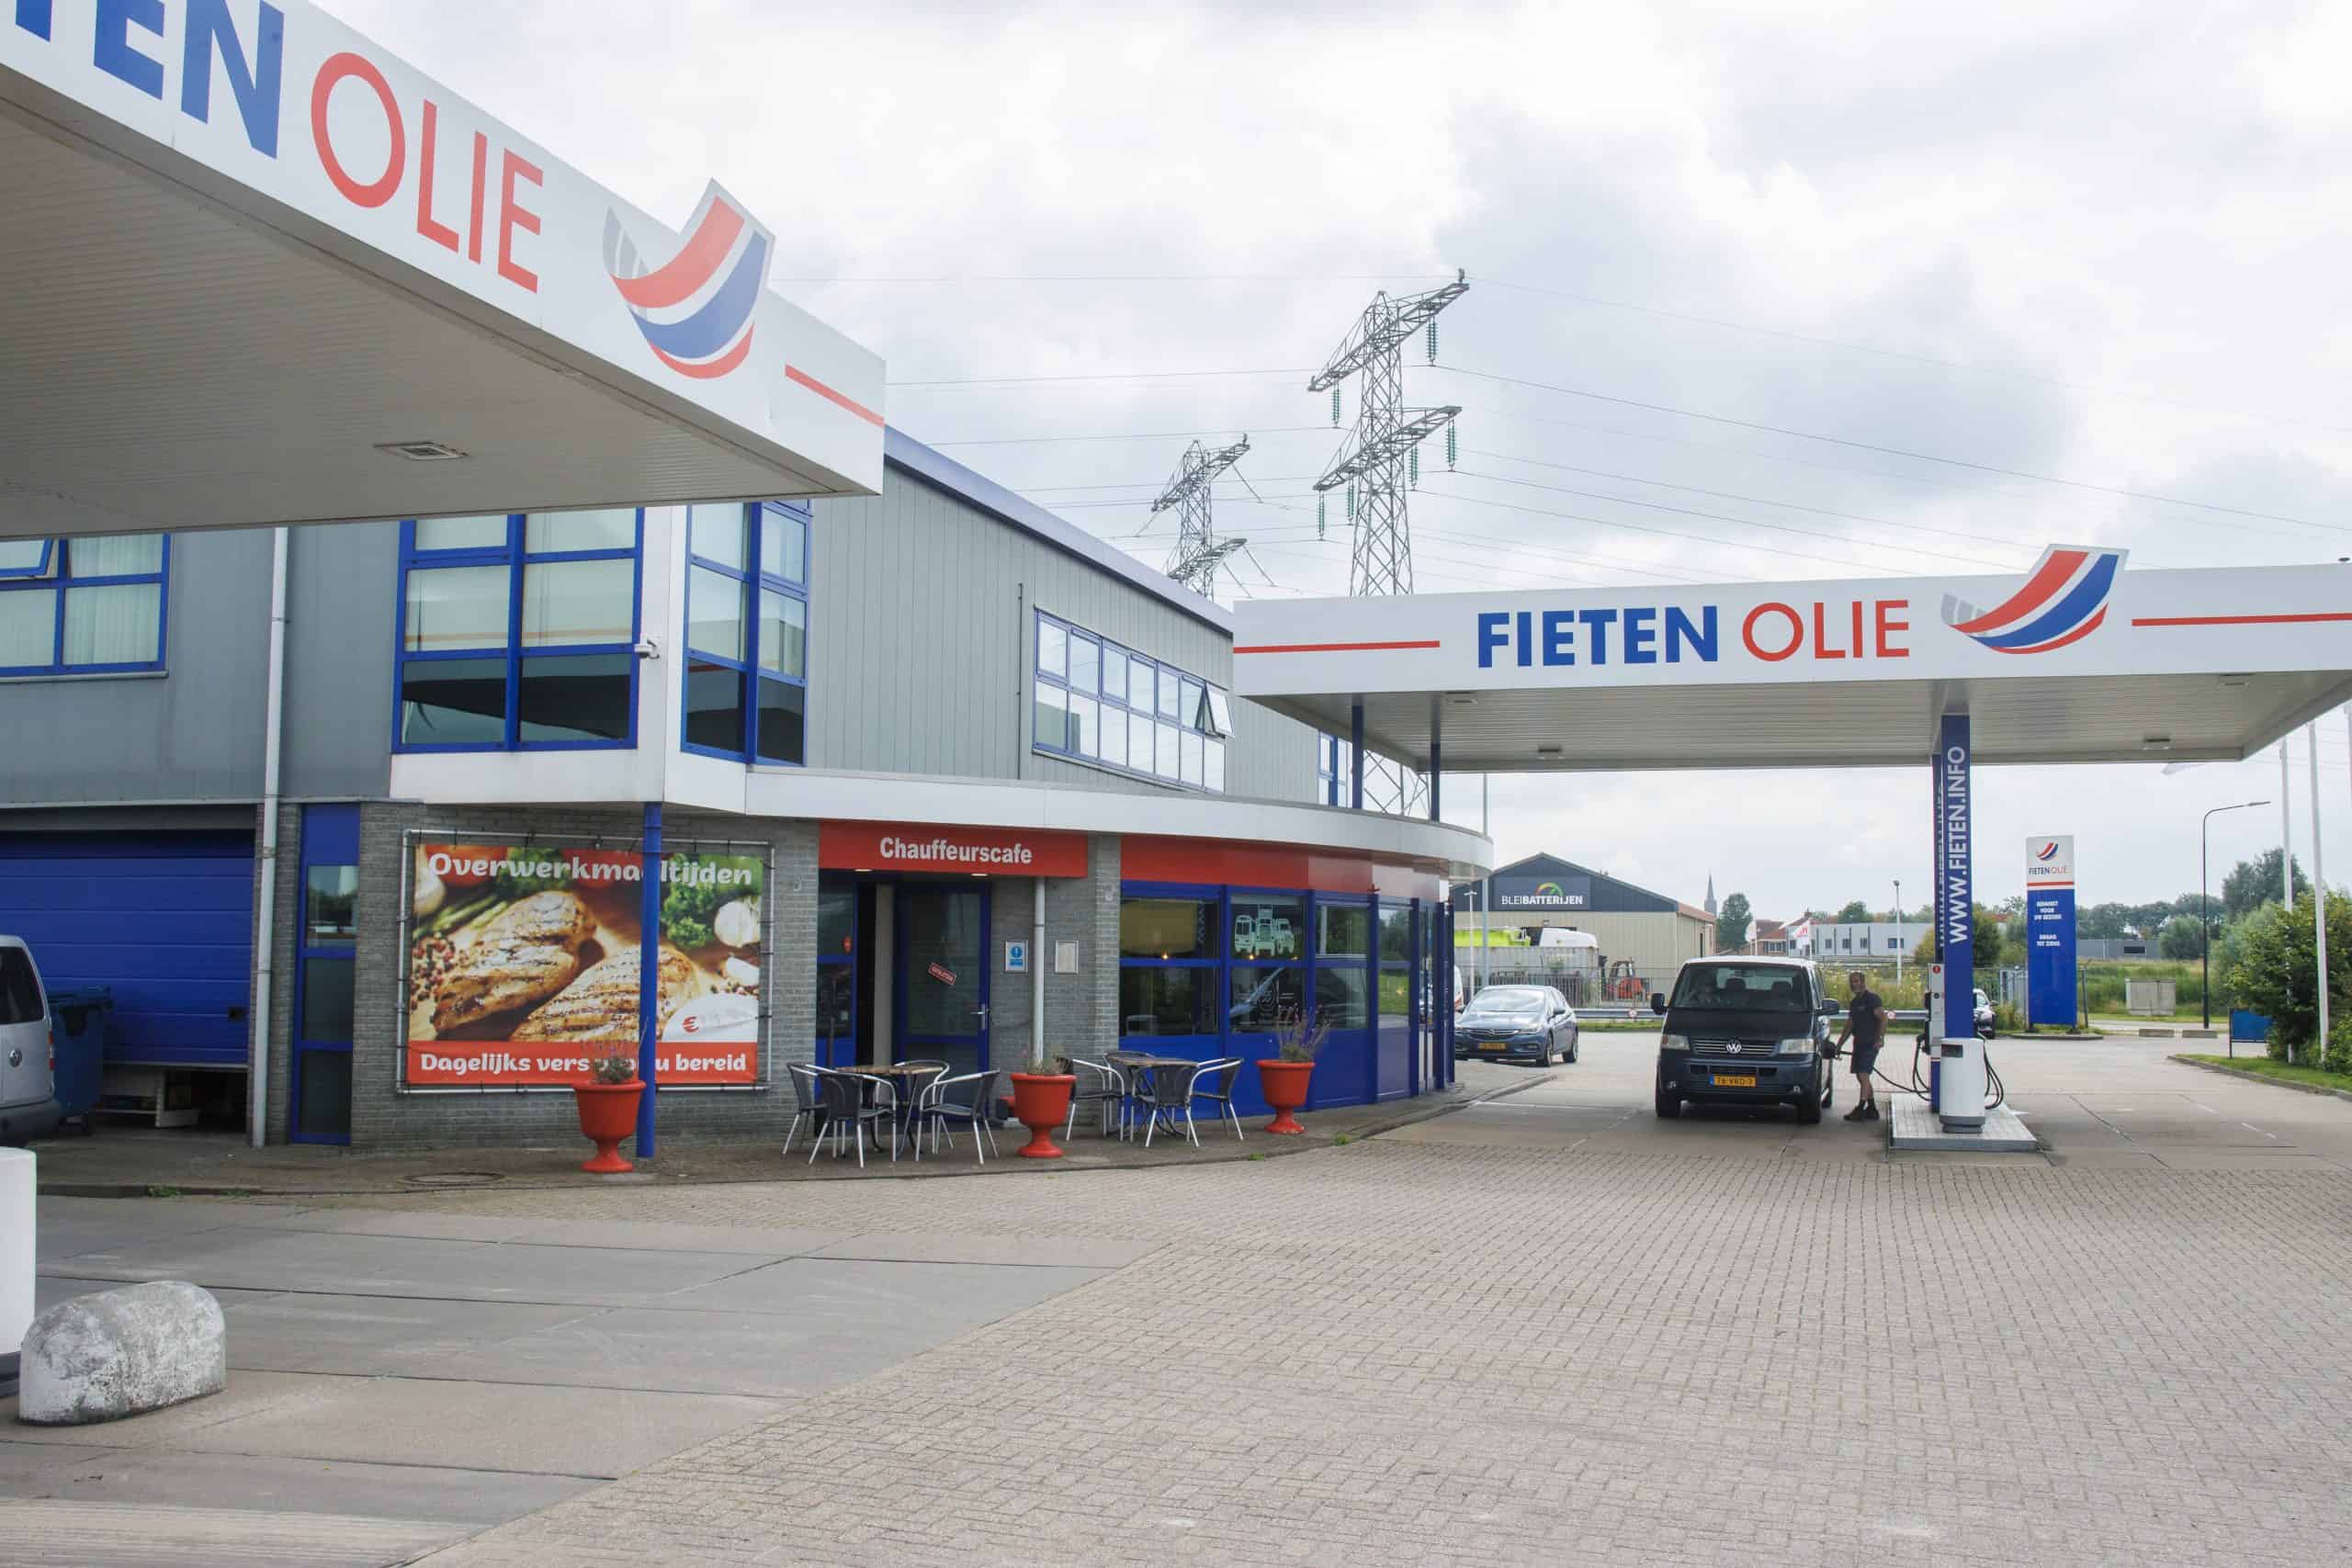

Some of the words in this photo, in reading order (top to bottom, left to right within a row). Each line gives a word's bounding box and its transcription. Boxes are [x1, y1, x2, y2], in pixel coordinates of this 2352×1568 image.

[311, 51, 543, 295] OLIE
[1477, 605, 1719, 668] FIETEN
[1742, 600, 1910, 662] OLIE
[879, 837, 1033, 864] Chauffeurscafe
[1947, 746, 1968, 944] WWW.FIETEN.INFO
[427, 852, 752, 887] Overwerkmaltijden
[1501, 896, 1583, 905] BLEIBATTERIJEN
[420, 1053, 532, 1077] Dagelijks
[536, 1057, 590, 1072] vers
[654, 1057, 670, 1072] u
[675, 1052, 747, 1072] bereid
